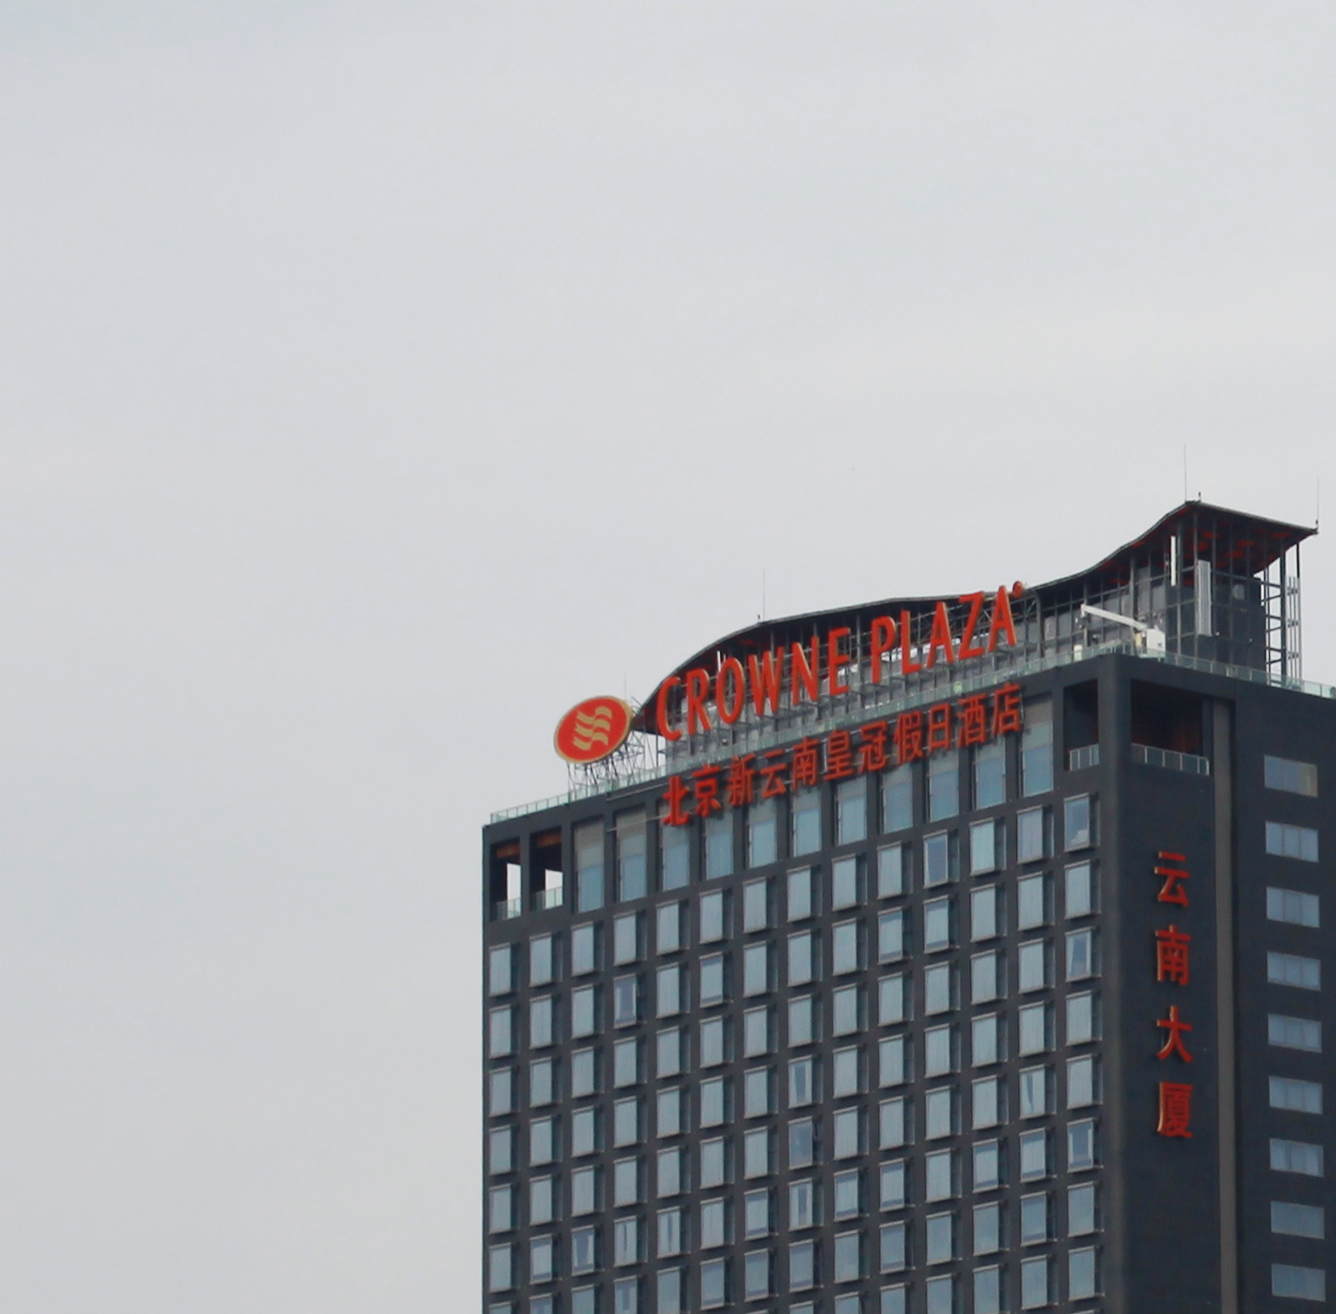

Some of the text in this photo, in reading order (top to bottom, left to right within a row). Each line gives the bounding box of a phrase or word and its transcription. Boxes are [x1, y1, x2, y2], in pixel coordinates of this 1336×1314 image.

[656, 585, 1017, 741] CROWNE PLAZA
[662, 682, 1022, 827] 北京新云南皇冠假日酒店
[1154, 851, 1194, 1139] 云南大厦
